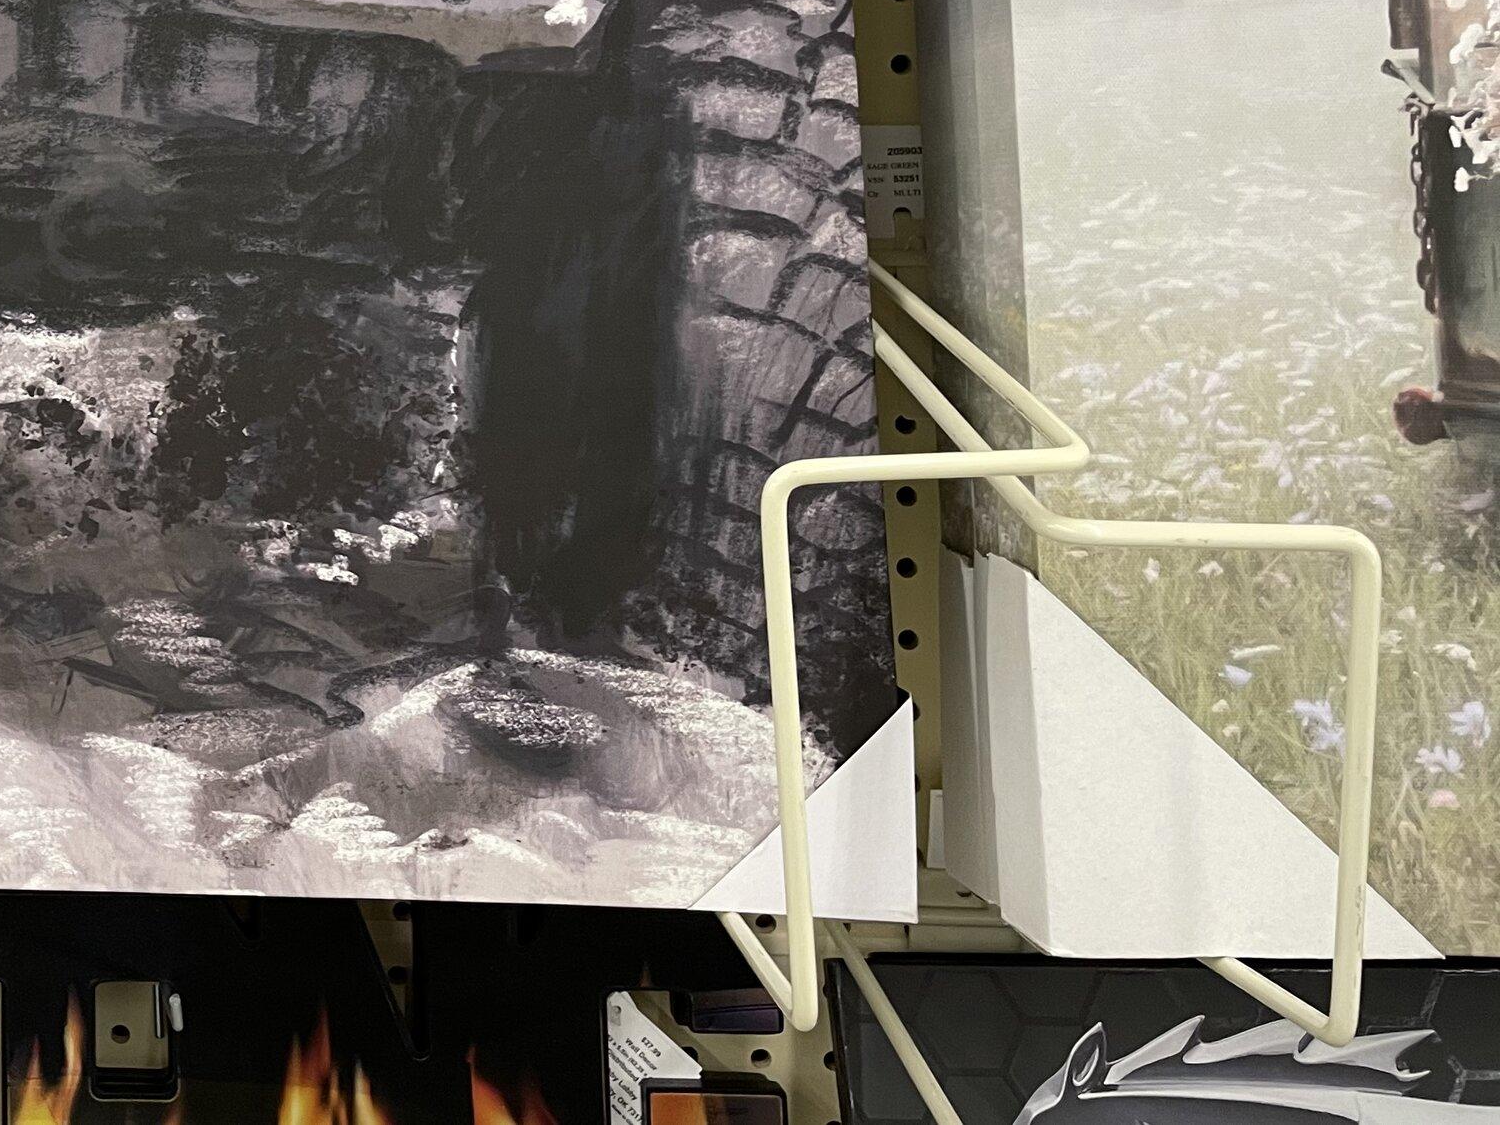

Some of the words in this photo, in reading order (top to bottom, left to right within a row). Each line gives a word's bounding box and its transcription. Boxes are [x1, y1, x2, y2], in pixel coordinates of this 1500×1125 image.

[893, 174, 919, 183] 53251
[625, 1038, 641, 1053] Wall
[617, 1097, 628, 1109] OK
